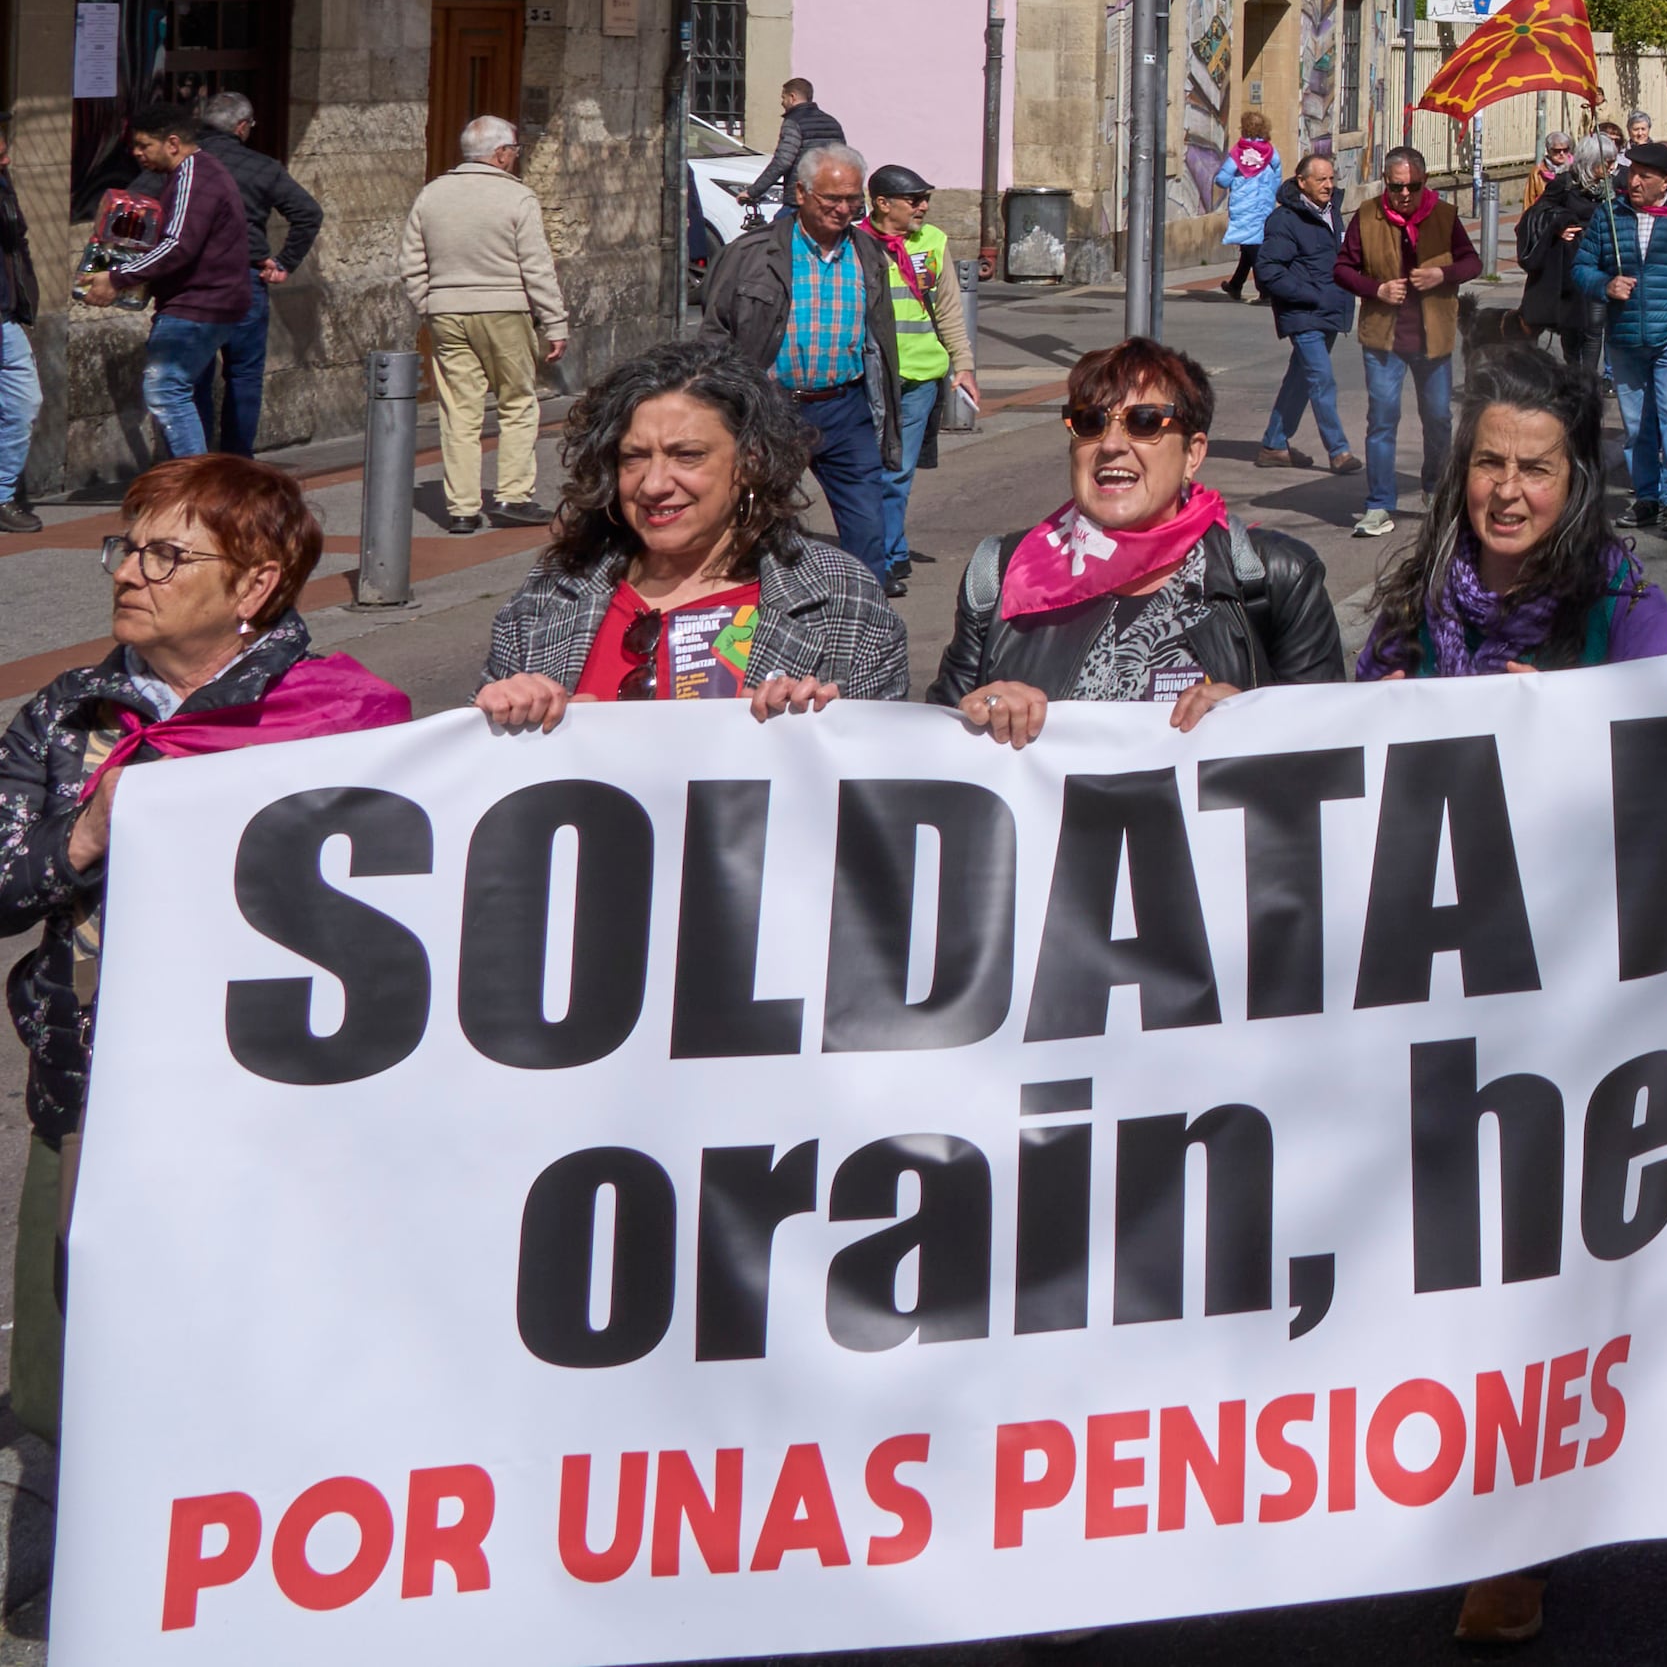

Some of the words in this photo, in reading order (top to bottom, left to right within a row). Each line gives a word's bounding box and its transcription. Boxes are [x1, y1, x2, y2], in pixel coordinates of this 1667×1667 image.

[675, 619, 720, 634] DUINAK
[674, 633, 703, 645] orain,
[675, 642, 709, 655] hemen
[675, 654, 692, 665] eta
[676, 658, 717, 673] DENONTZAT
[1154, 678, 1196, 692] DUINAK
[226, 735, 1541, 1086] SOLDATA
[516, 1077, 1336, 1369] orain,
[161, 1465, 496, 1633] POR
[558, 1435, 933, 1585] UNAS
[993, 1335, 1631, 1551] PENSIONES
